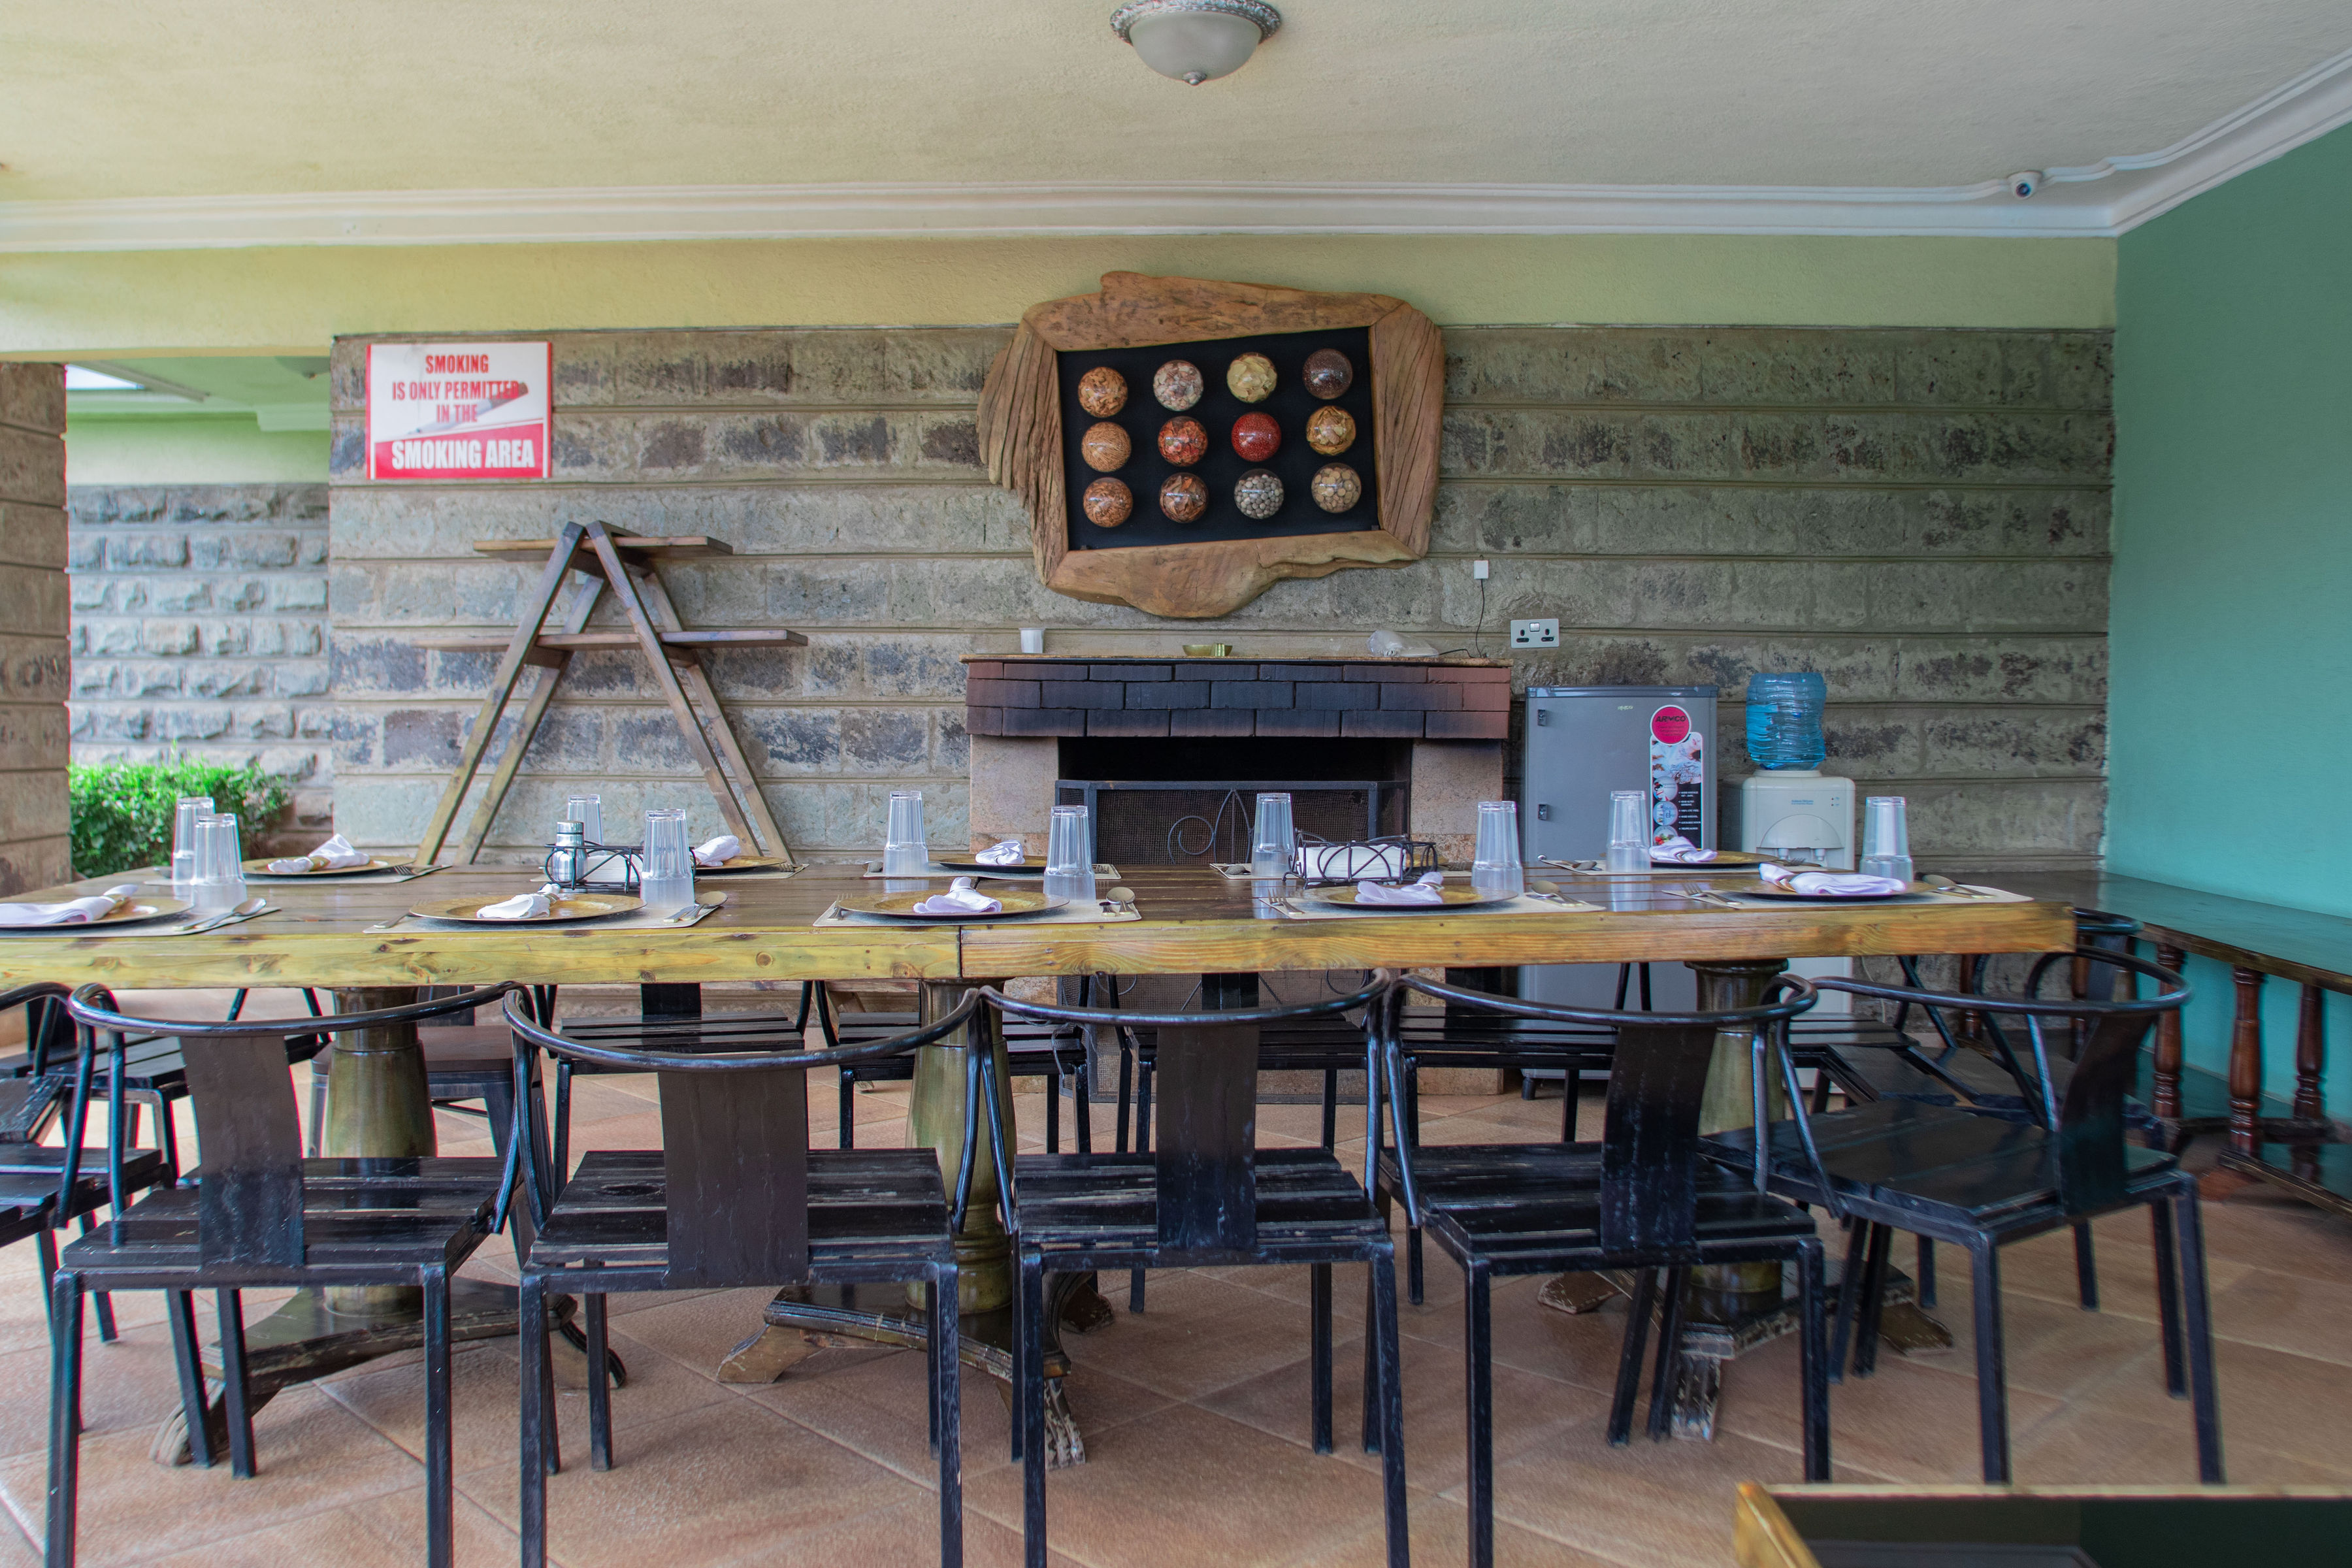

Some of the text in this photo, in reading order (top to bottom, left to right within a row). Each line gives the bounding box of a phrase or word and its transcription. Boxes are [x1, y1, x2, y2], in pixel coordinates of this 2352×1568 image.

[425, 355, 489, 373] SMOKING
[393, 381, 519, 400] IS ONLY PERMITTED
[436, 404, 478, 423] IN THE
[392, 440, 535, 469] SMOKING AREA
